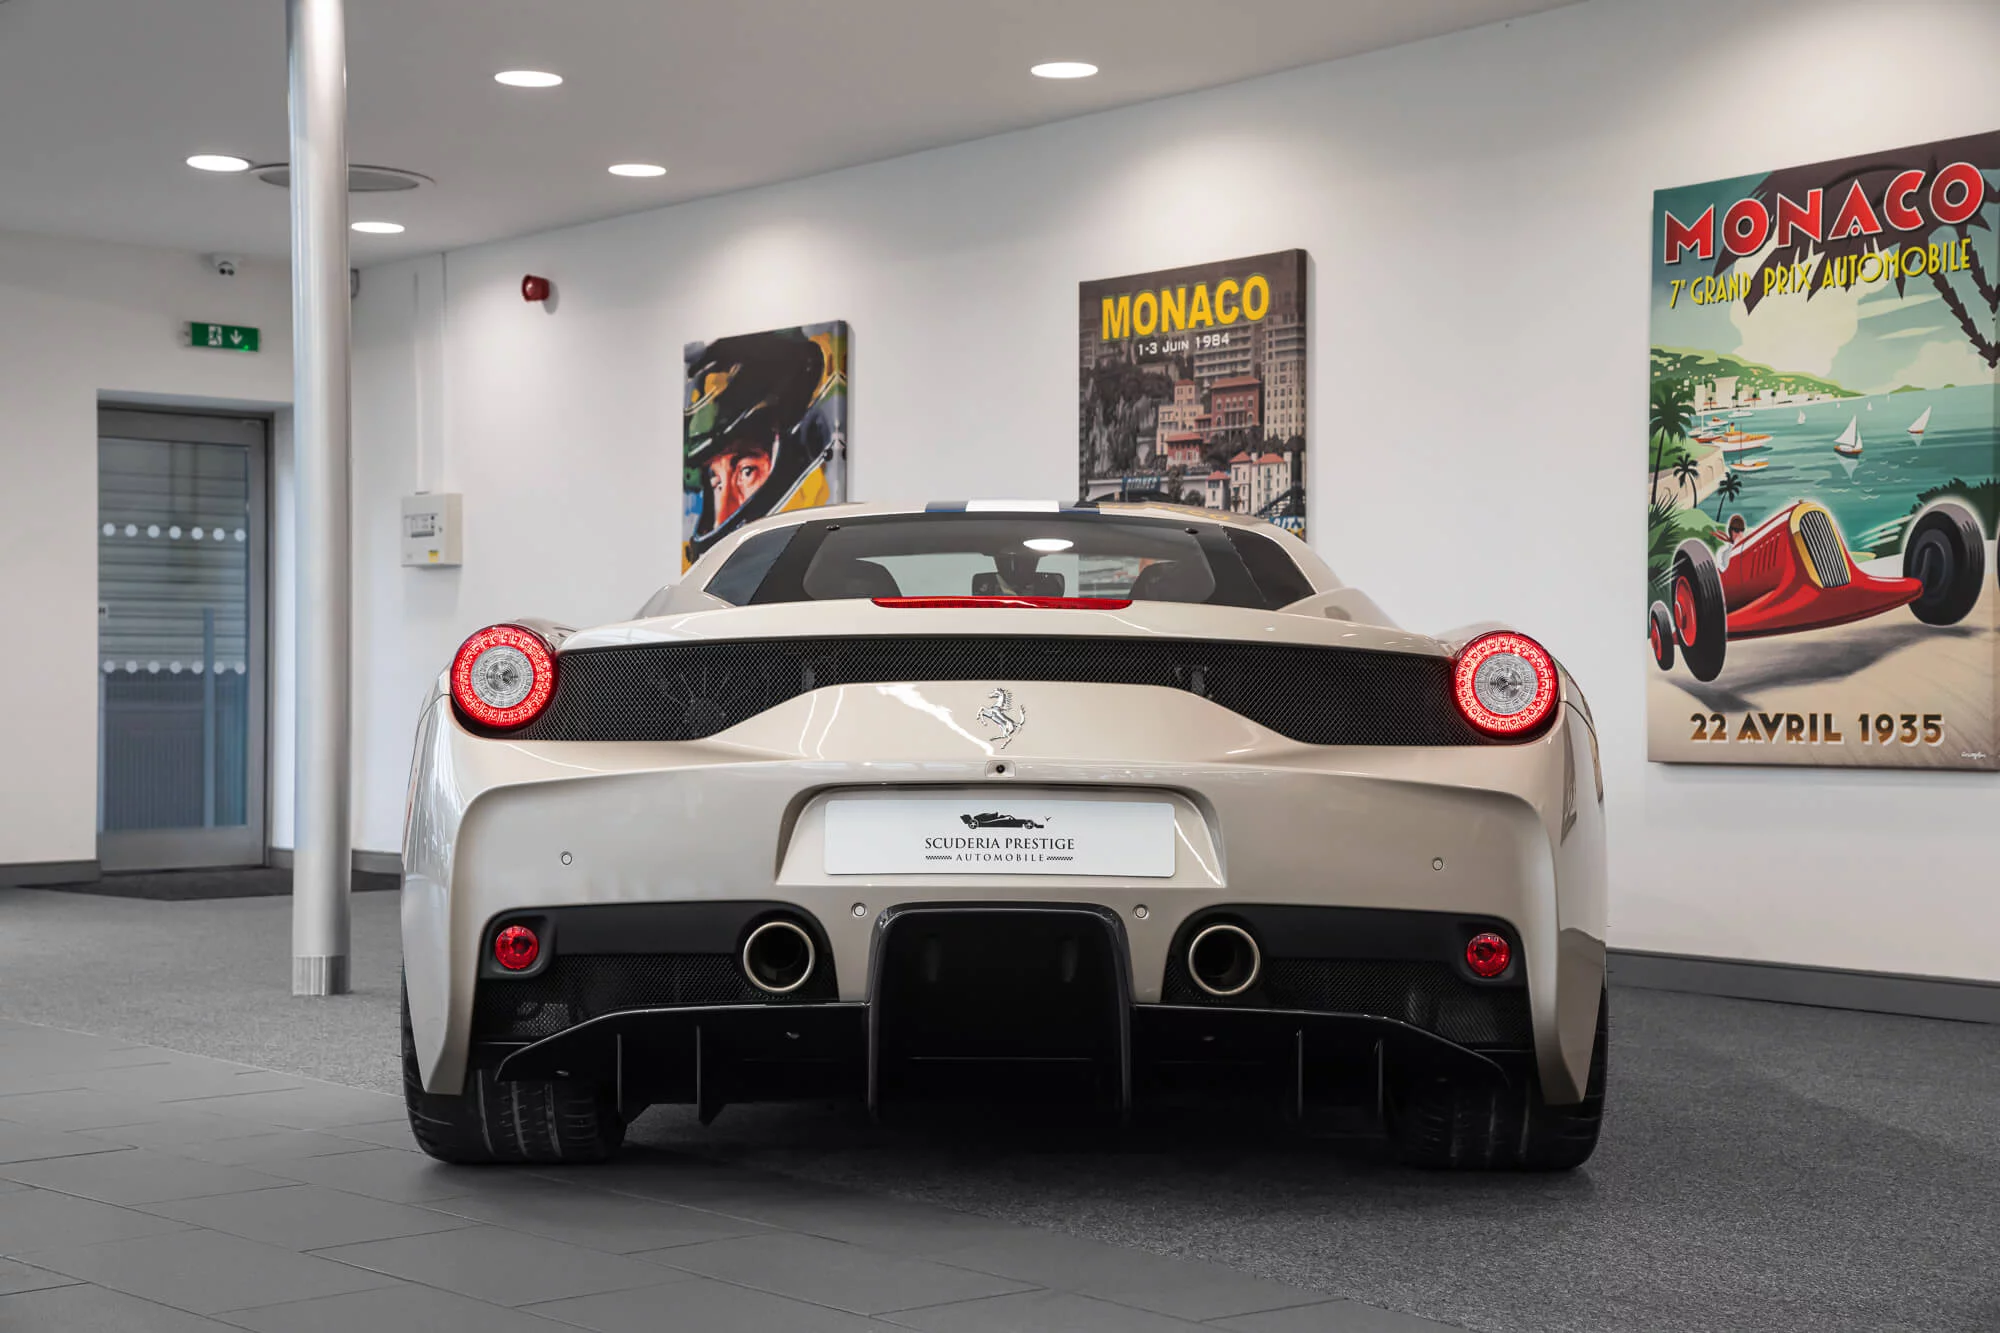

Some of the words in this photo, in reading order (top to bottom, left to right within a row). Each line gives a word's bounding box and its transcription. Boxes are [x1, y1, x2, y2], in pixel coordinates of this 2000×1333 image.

[1664, 162, 1985, 264] MONACO
[1690, 271, 1752, 305] GRAND
[1763, 262, 1812, 297] PRIX
[1822, 238, 1972, 289] AUTOMOBILE
[1101, 274, 1270, 341] MONACO
[1195, 332, 1230, 349] 1984
[1690, 713, 1729, 744] 22
[1736, 713, 1844, 745] AVRIL
[1858, 713, 1945, 747] 1935
[925, 837, 1000, 849] SCUDERIA
[1005, 838, 1075, 850] PRESTIGE
[956, 853, 1044, 862] AUTOMOBILE
